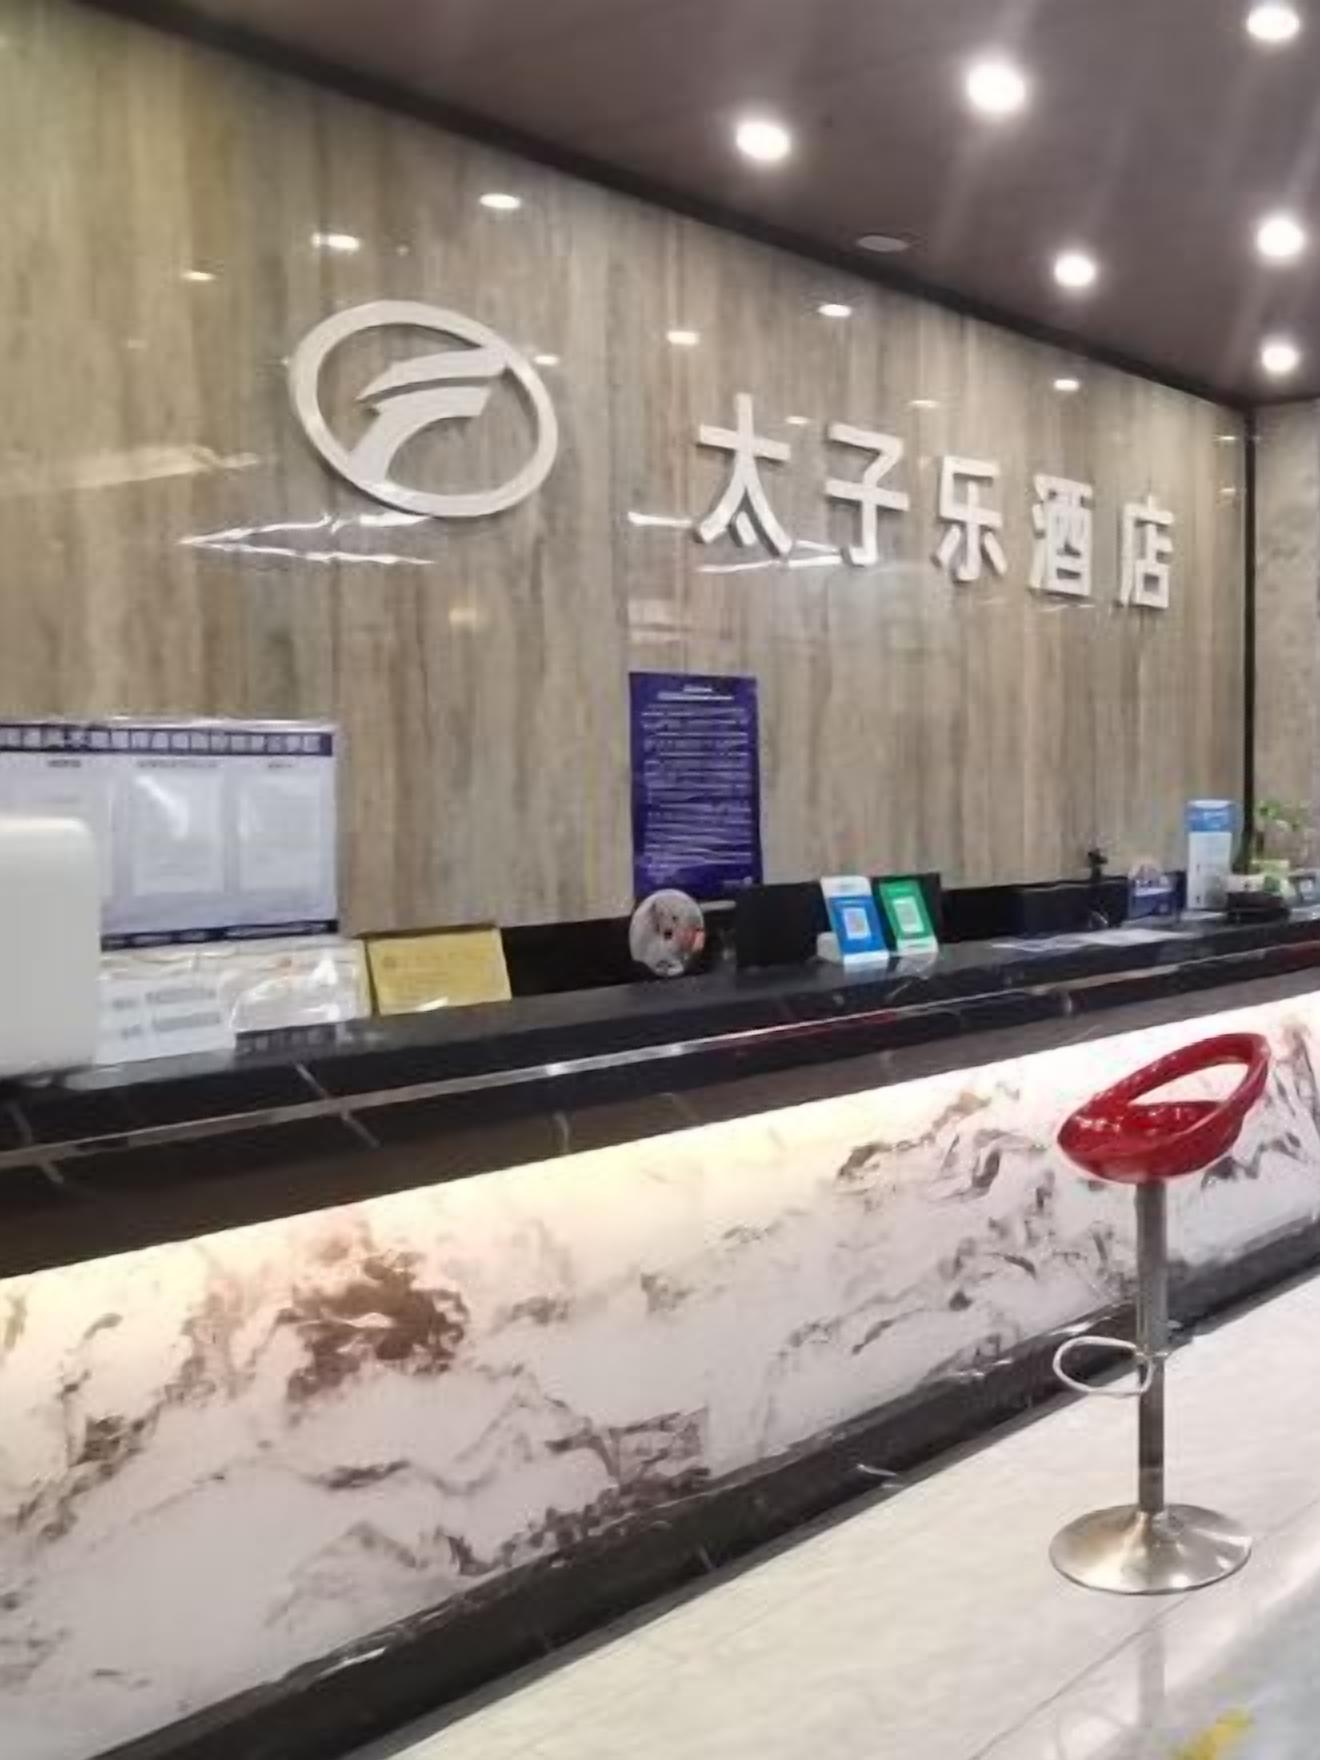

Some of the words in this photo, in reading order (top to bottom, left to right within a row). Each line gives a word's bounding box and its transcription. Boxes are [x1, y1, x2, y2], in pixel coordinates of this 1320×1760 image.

[697, 392, 1174, 609] 太子乐酒店
